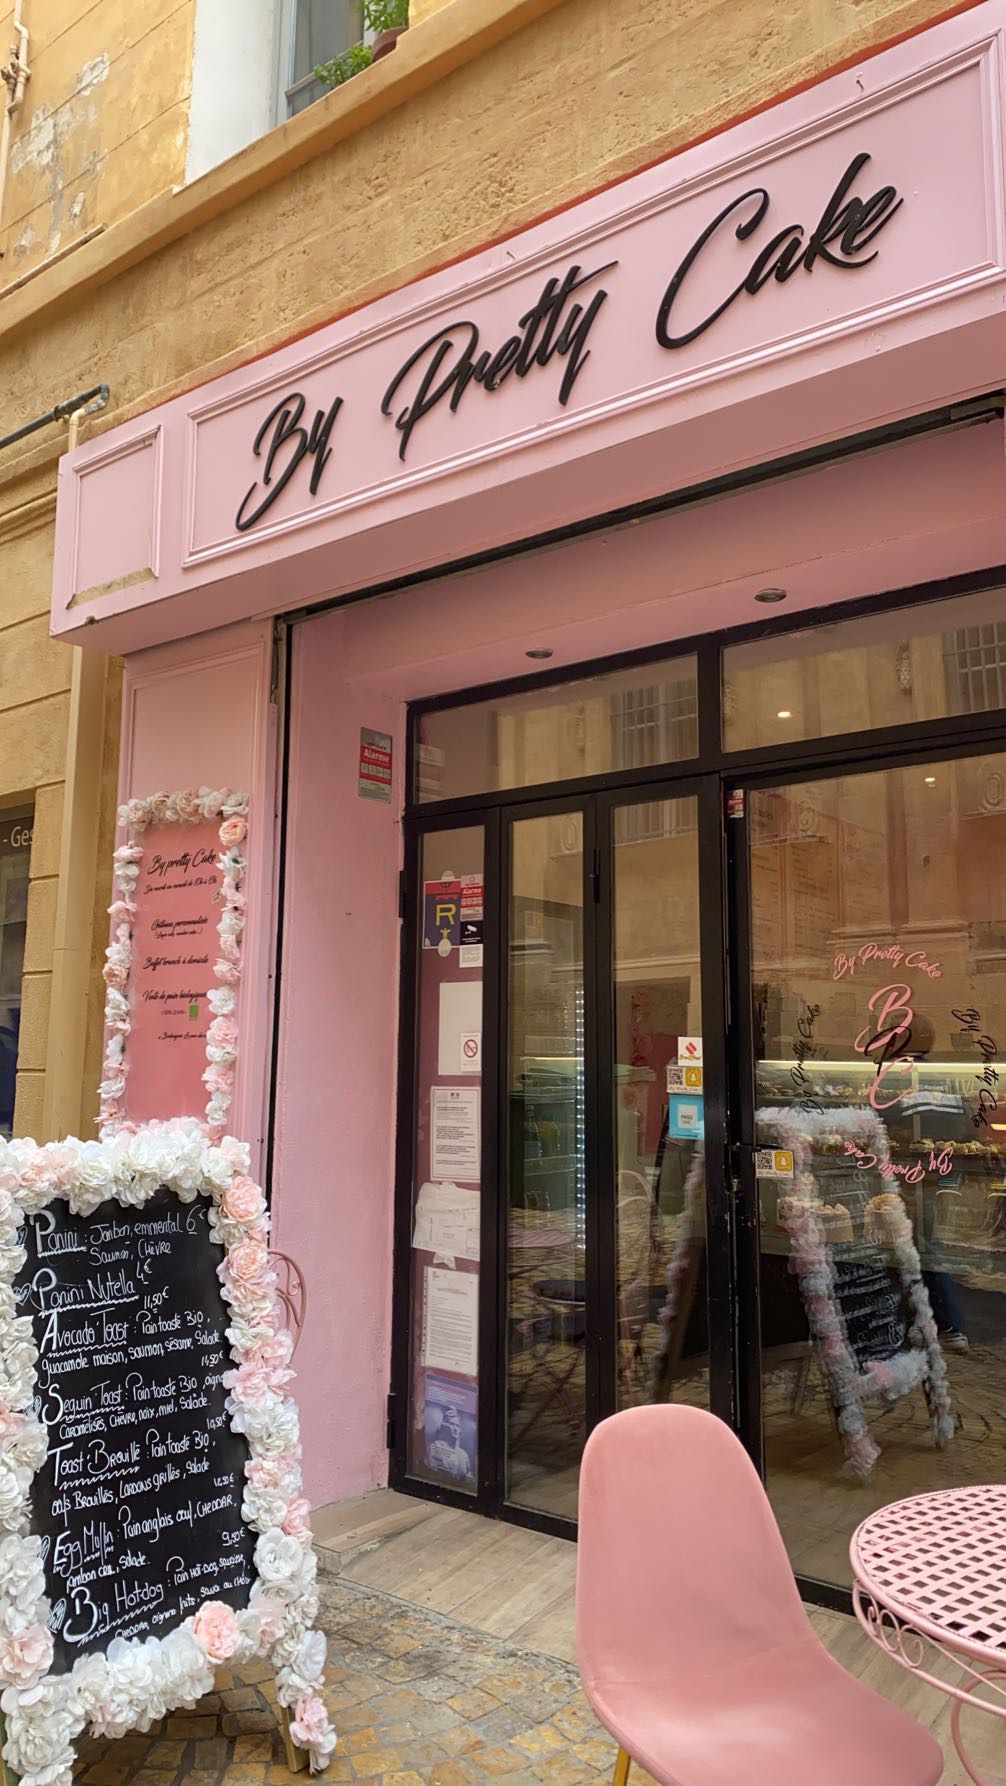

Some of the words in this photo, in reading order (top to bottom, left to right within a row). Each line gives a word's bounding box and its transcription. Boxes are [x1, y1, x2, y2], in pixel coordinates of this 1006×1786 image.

[236, 392, 344, 531] By
[381, 260, 618, 462] Pretty
[656, 152, 904, 351] Cake
[363, 748, 390, 763] Alarme
[147, 854, 167, 877] By
[192, 847, 217, 868] Cake
[833, 953, 856, 980] By
[858, 942, 904, 968] Pretty
[905, 951, 942, 979] Cake
[797, 1004, 821, 1039] Cake
[951, 1007, 981, 1033] By
[790, 1041, 817, 1087] Pretty
[972, 1034, 1000, 1087] Pretty
[800, 1089, 825, 1115] By
[973, 1088, 997, 1129] Cake
[843, 1139, 877, 1169] Cake
[879, 1154, 926, 1184] Pretty
[929, 1146, 954, 1176] By
[35, 1209, 78, 1251] Panini
[134, 1211, 184, 1236] emmental
[31, 1267, 84, 1310] Panini
[87, 1268, 137, 1301] Nutella
[40, 1311, 95, 1353] Avocado
[90, 1308, 129, 1343] Toast
[136, 1310, 157, 1335] Pain
[38, 1353, 89, 1388] guacamole
[93, 1352, 128, 1367] maison,
[41, 1383, 92, 1426] Seguin
[90, 1380, 121, 1405] Toast
[125, 1372, 150, 1401] Pain
[47, 1442, 83, 1486] Toast
[145, 1428, 167, 1459] Pain
[53, 1531, 82, 1577] Egg
[118, 1505, 142, 1539] Pain
[142, 1508, 174, 1542] anglais
[63, 1586, 109, 1643] Big
